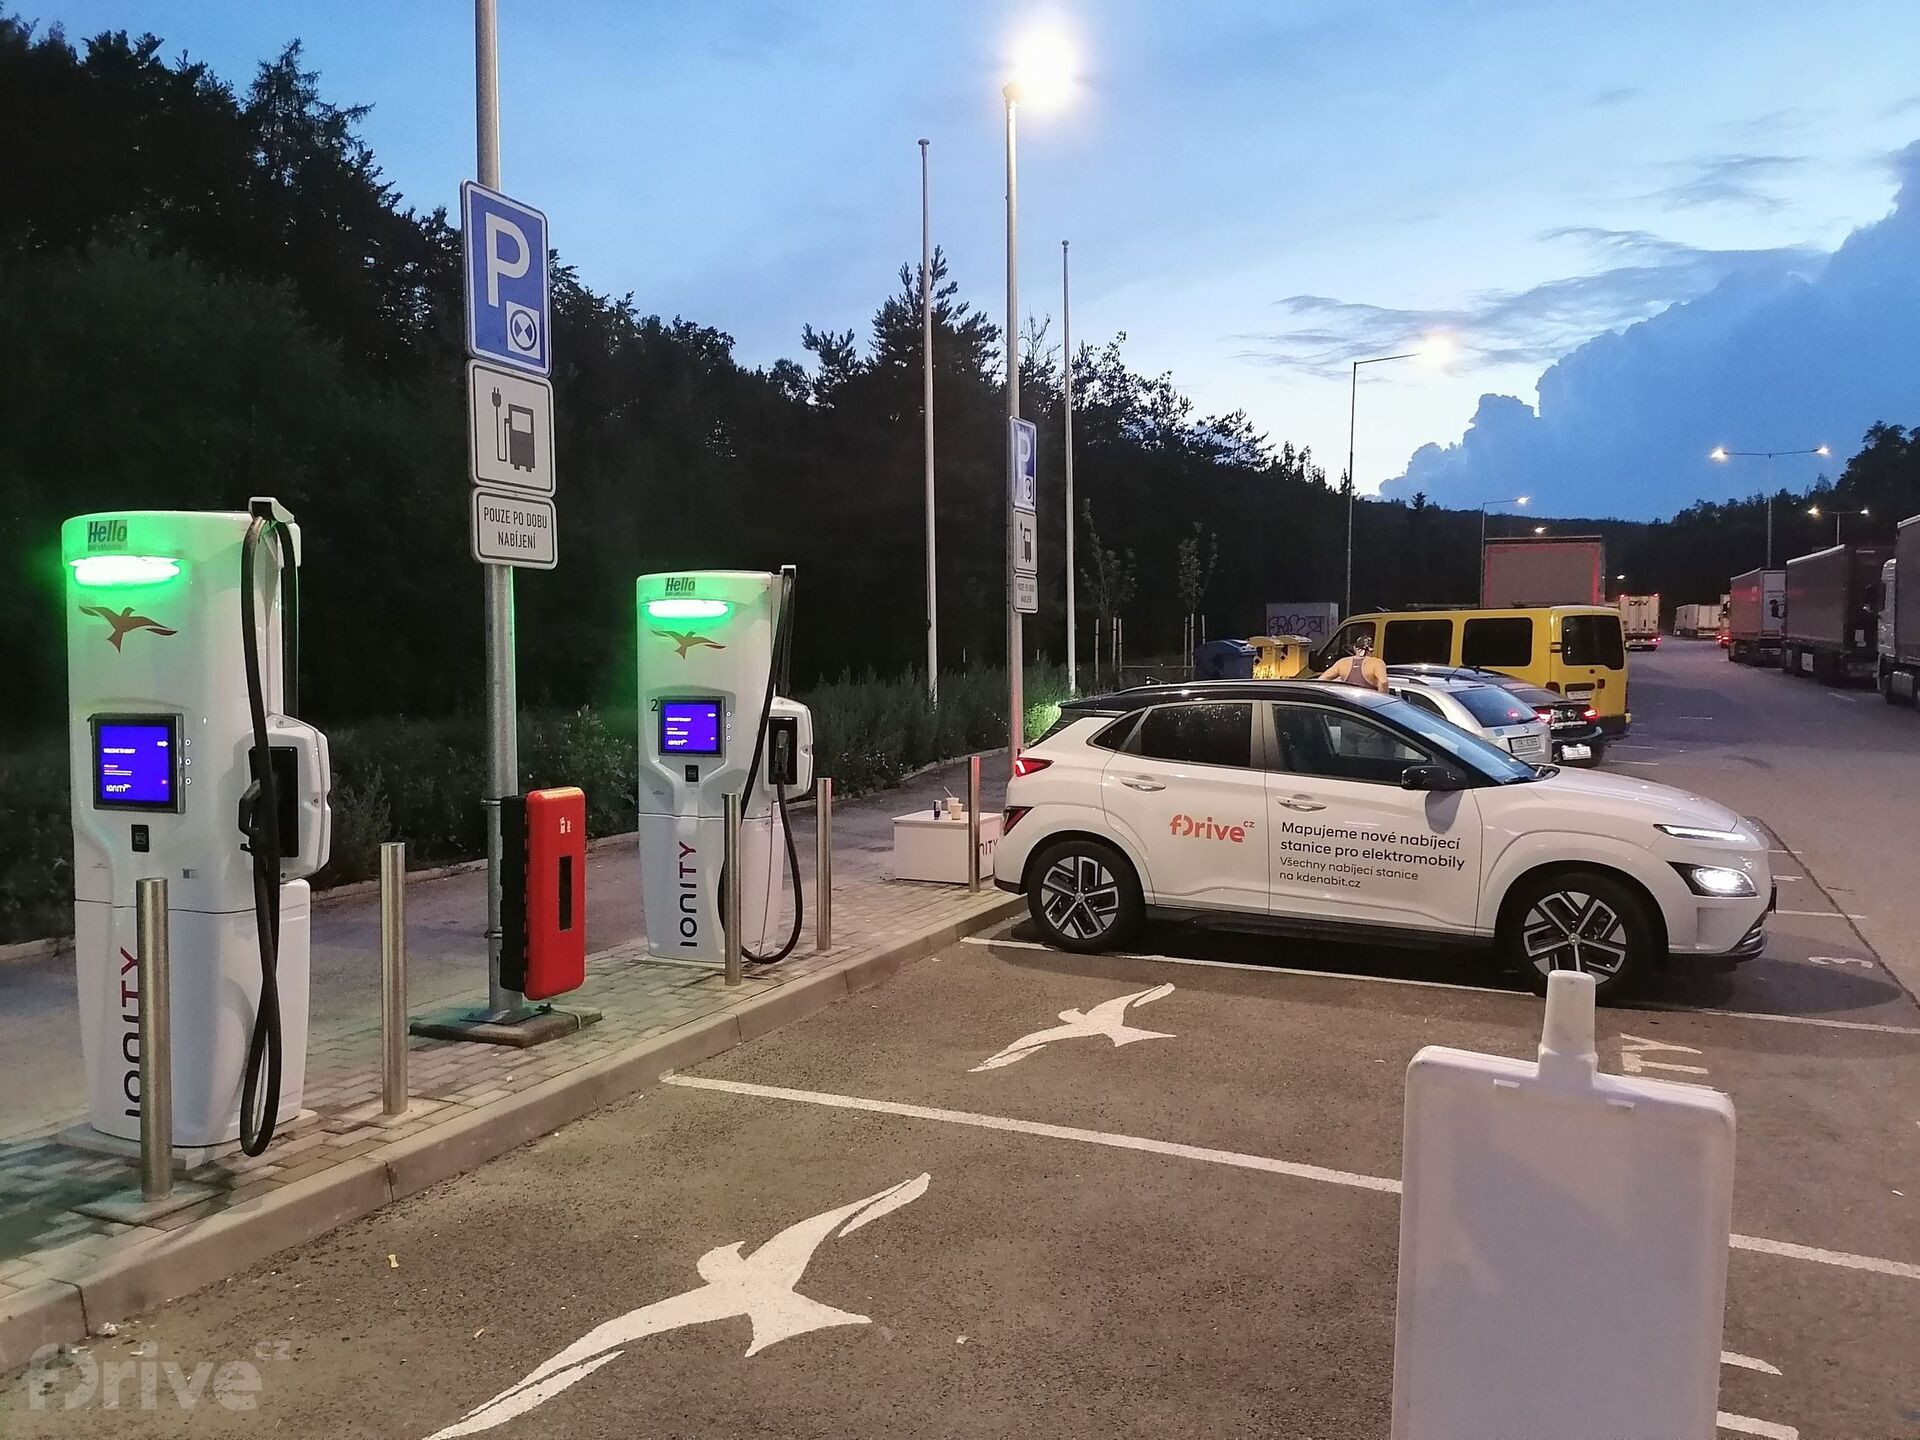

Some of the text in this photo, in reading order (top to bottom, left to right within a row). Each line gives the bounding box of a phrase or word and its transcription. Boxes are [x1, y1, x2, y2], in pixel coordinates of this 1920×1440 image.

[485, 212, 531, 308] P
[1017, 430, 1032, 479] P
[483, 506, 548, 529] POUZE PO DOBU
[88, 520, 127, 543] Hello
[497, 530, 536, 549] NABÍJENÍ
[665, 577, 696, 591] Hello
[650, 698, 658, 712] 2
[1281, 821, 1462, 850] Mapujeme nové nabíjecí
[1280, 839, 1465, 871] stanice pro elektromobily
[1279, 856, 1419, 881] Všechny nabíjecí stanice
[1279, 871, 1361, 889] na kdenabit.cz
[678, 840, 698, 947] IONITY
